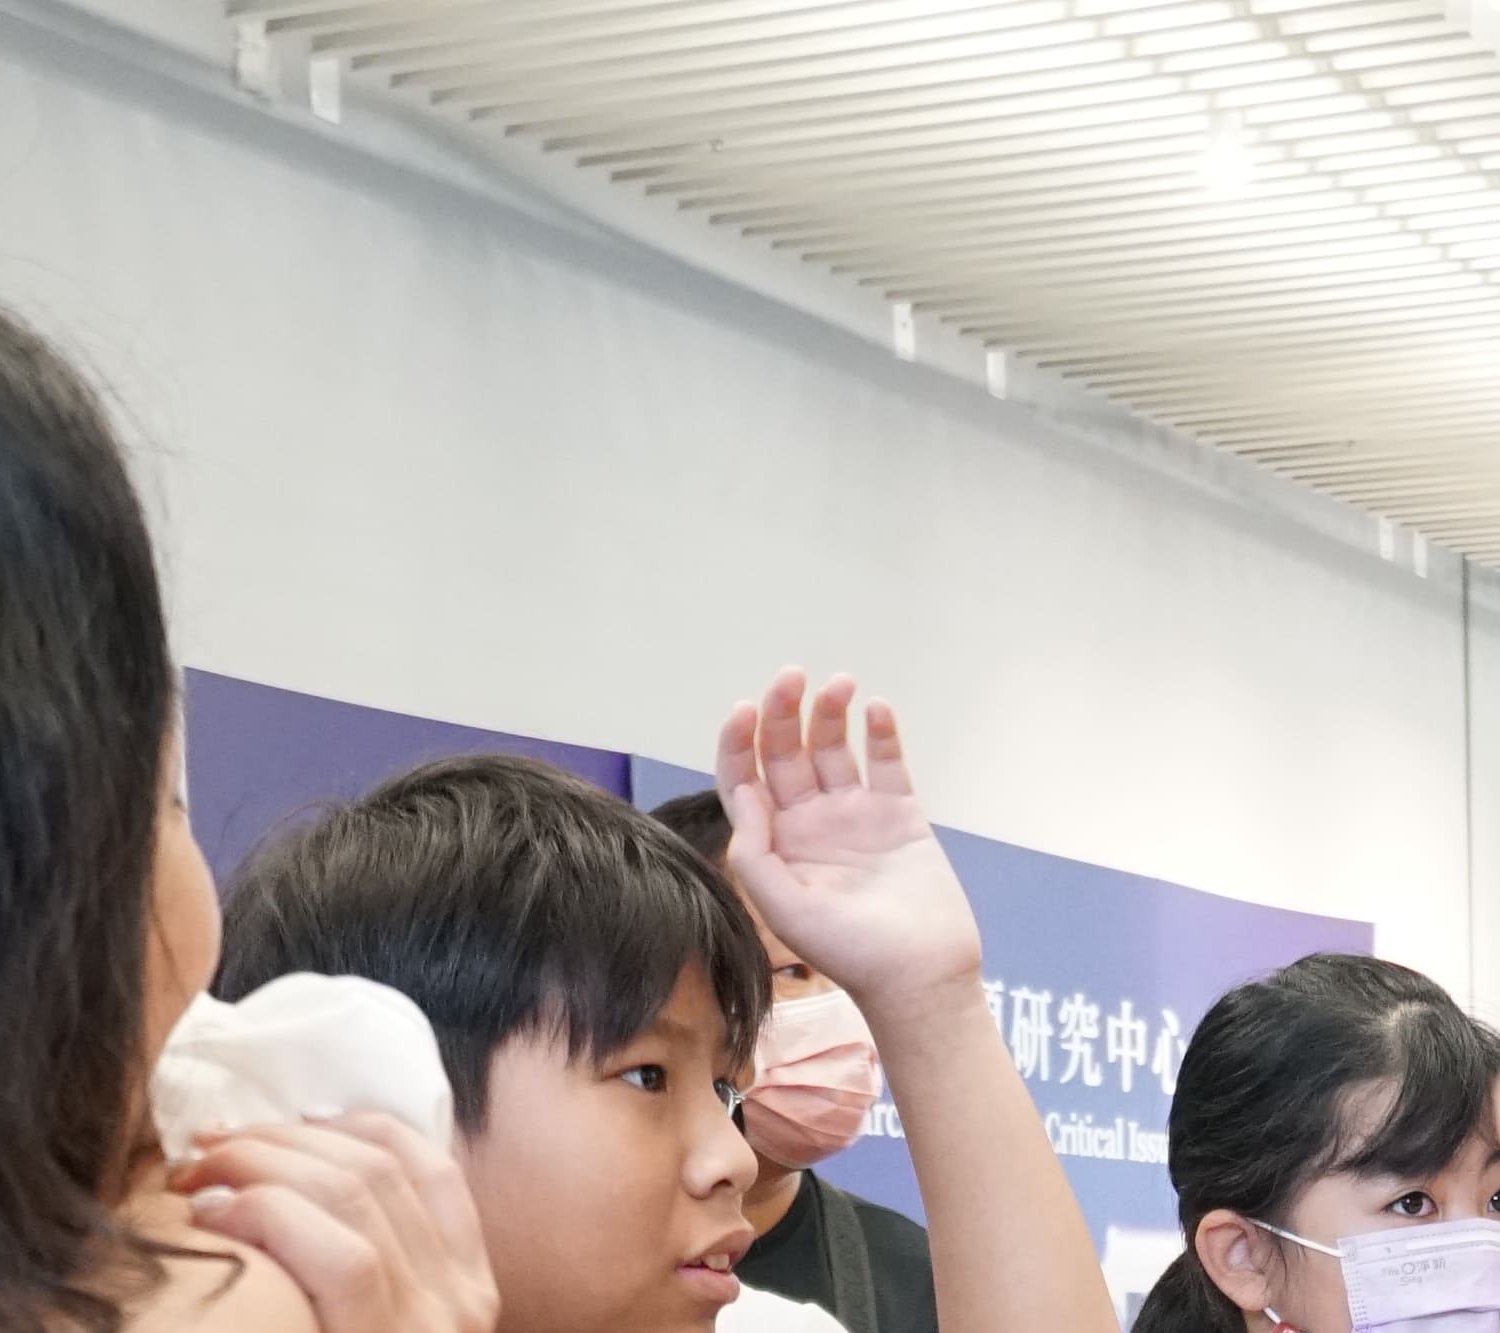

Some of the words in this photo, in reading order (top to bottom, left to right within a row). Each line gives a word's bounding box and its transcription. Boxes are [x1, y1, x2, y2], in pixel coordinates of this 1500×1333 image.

[983, 980, 1186, 1097] 研究中心
[1045, 1111, 1124, 1159] Critical
[1127, 1121, 1169, 1165] Issu
